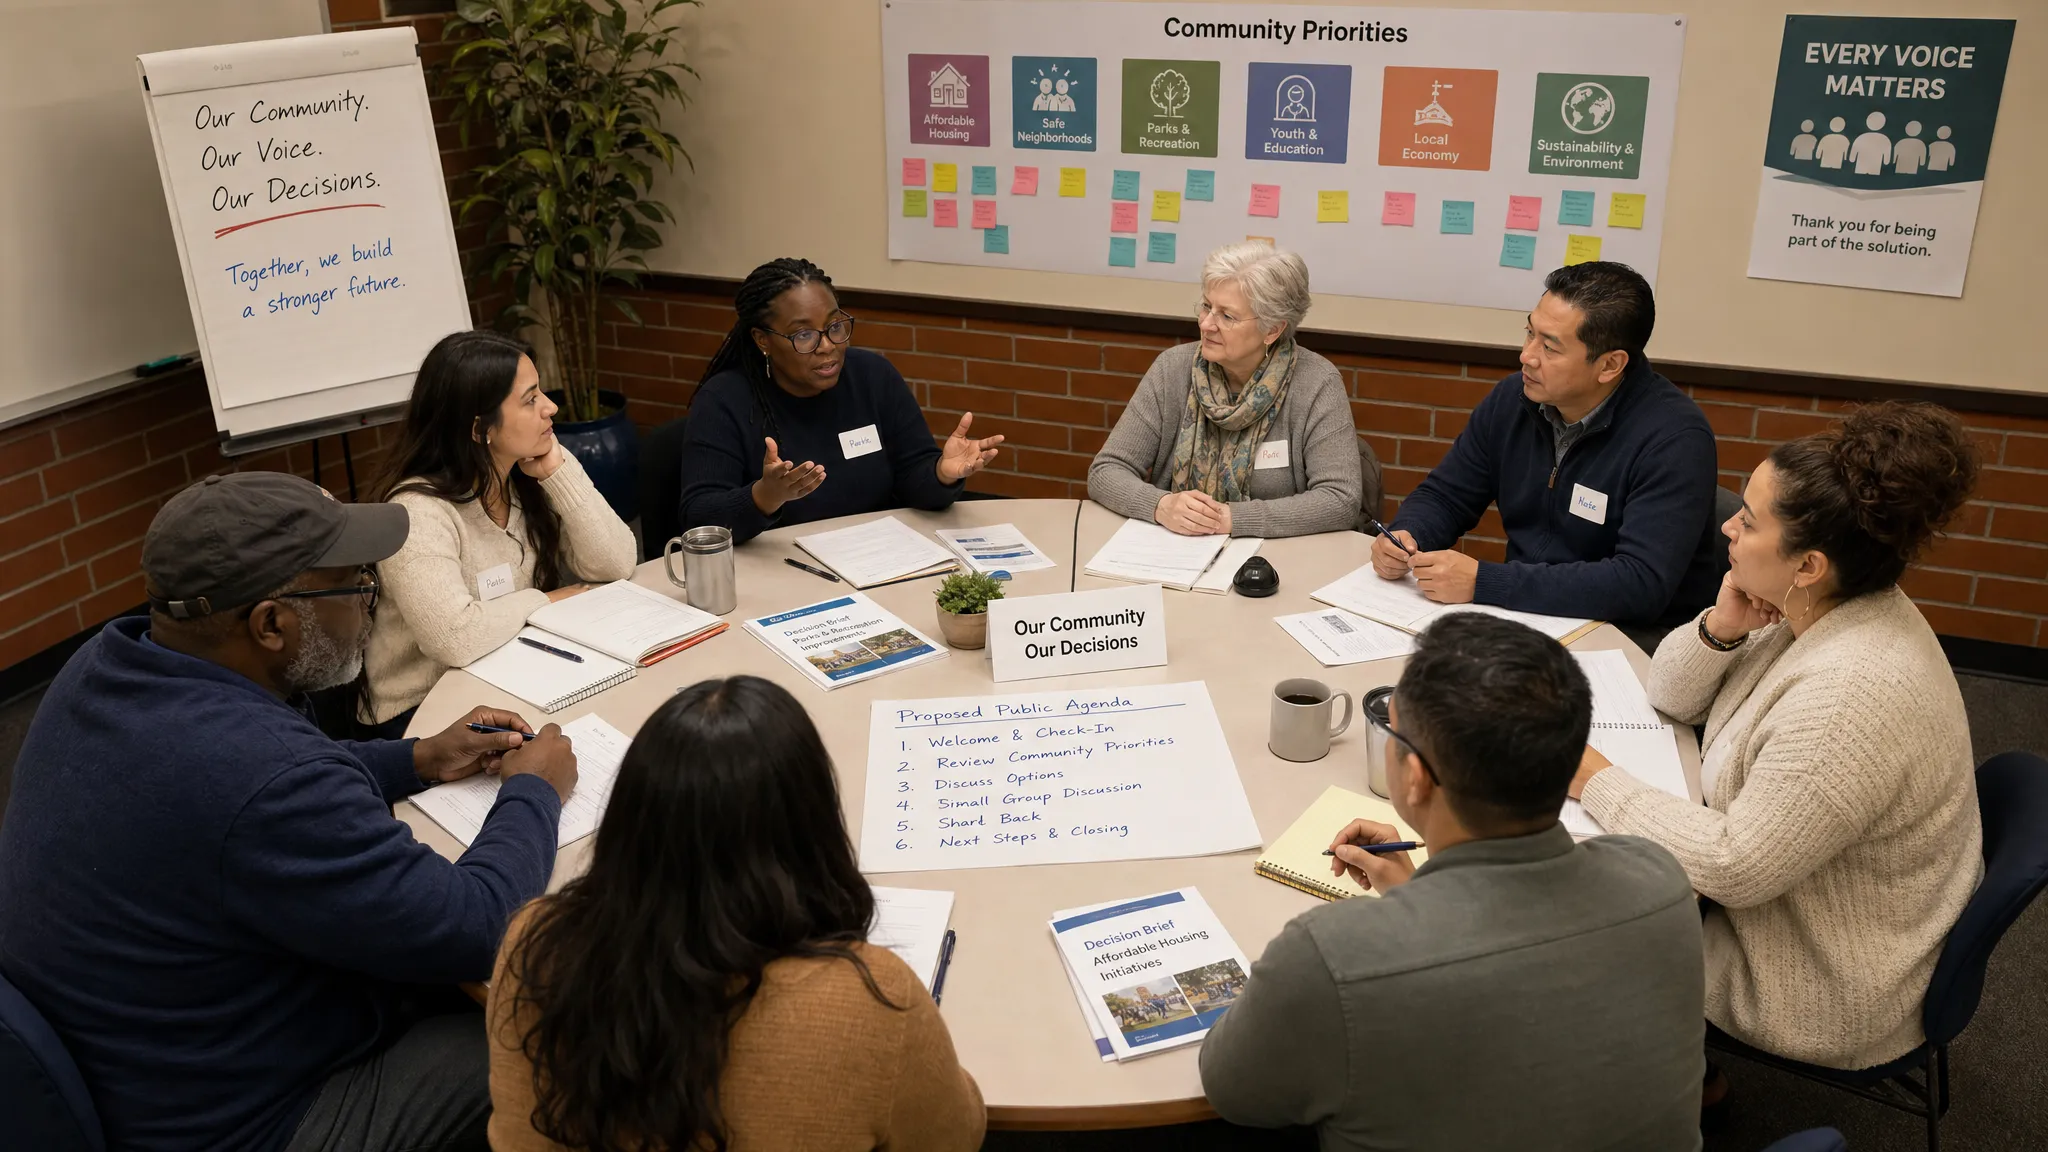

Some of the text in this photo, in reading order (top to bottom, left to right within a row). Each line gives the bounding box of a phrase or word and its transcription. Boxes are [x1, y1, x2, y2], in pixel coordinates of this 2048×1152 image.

[1165, 17, 1407, 45] Community Priorities
[1805, 43, 1975, 68] EVERY VOICE
[1825, 75, 1945, 99] MATTERS
[196, 90, 368, 129] Our Community.
[924, 114, 974, 126] Affordable
[930, 128, 969, 142] Housing
[1043, 118, 1065, 128] Safe
[1148, 123, 1190, 134] Parks &
[1271, 128, 1317, 139] Youth &
[1018, 132, 1092, 144] Neighborhoods
[1140, 137, 1199, 149] Recreation
[1265, 142, 1323, 154] Education
[1415, 133, 1448, 145] Local
[1537, 140, 1634, 156] Sustainability &
[202, 138, 321, 170] Our Voice.
[1403, 148, 1459, 163] Economy
[1543, 155, 1623, 169] Environment
[213, 172, 380, 211] Our Decisions.
[1792, 214, 1936, 241] Thank you for being
[1788, 236, 1931, 256] part of the solution.
[225, 238, 392, 287] Together, we build
[243, 275, 405, 318] a stronger future.
[1015, 609, 1145, 635] Our Community
[1025, 635, 1138, 659] Our Decisions
[897, 697, 1133, 723] Proposed Public Agenda
[902, 724, 1114, 751] 1. Welcome & Check-In
[897, 738, 1173, 772] 2. Review Community Priorities
[898, 772, 1063, 792] 3. Discuss Options
[896, 800, 913, 811] 4.
[1003, 794, 1051, 805] Group
[1063, 783, 1141, 798] Discussion
[897, 820, 913, 831] 5.
[1000, 811, 1041, 823] Back
[896, 825, 1128, 849] 6. Next Steps & Closing
[1084, 920, 1175, 950] Decision Brief
[1094, 930, 1209, 966] Affordable Housing
[1100, 958, 1162, 981] Initiatives
